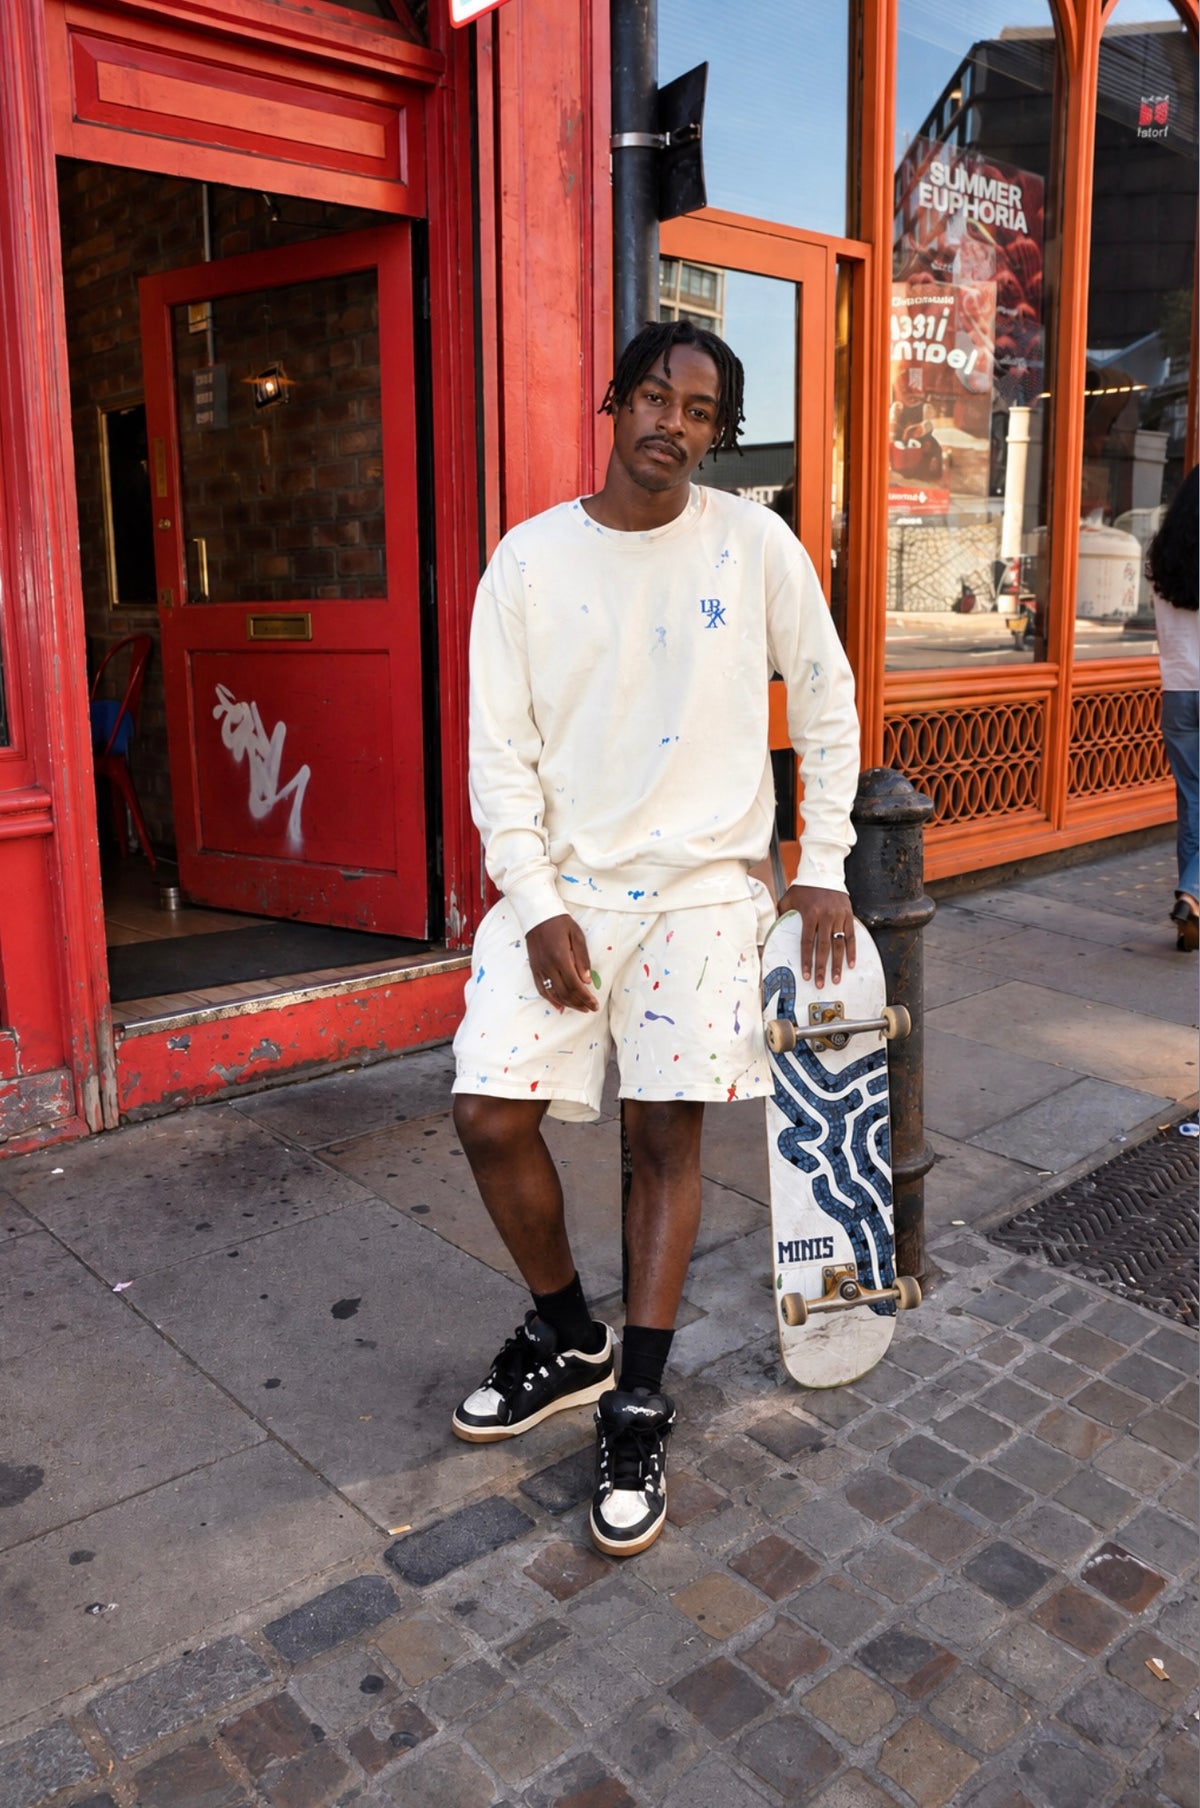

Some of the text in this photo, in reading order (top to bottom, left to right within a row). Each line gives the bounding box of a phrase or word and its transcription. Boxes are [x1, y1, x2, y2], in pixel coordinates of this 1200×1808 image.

[919, 181, 1029, 235] EUPHORIA
[929, 161, 1022, 210] SUMMER
[778, 1236, 834, 1264] MINIS
